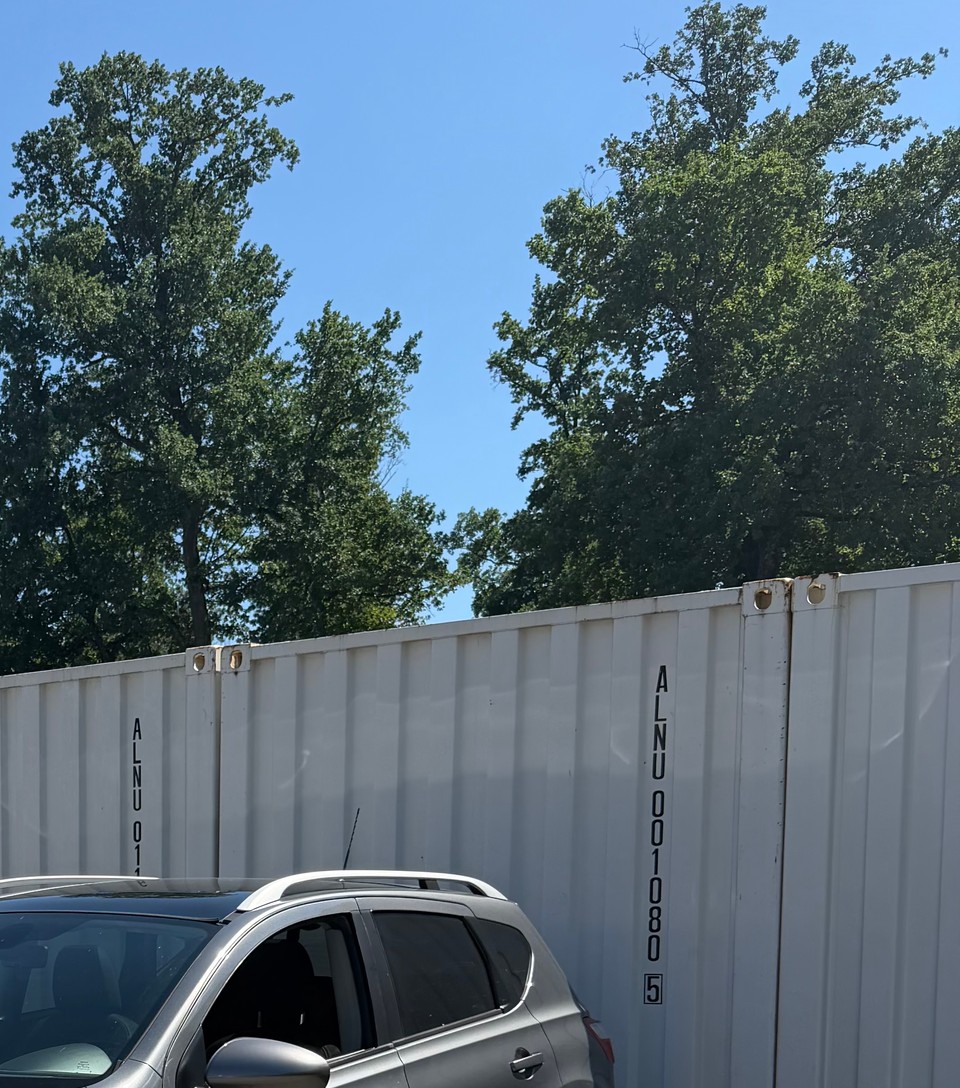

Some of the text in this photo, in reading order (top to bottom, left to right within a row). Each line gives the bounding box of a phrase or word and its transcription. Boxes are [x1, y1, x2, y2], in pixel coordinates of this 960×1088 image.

[132, 717, 142, 812] ALNU
[652, 664, 668, 780] ALNU
[647, 790, 665, 962] 001080
